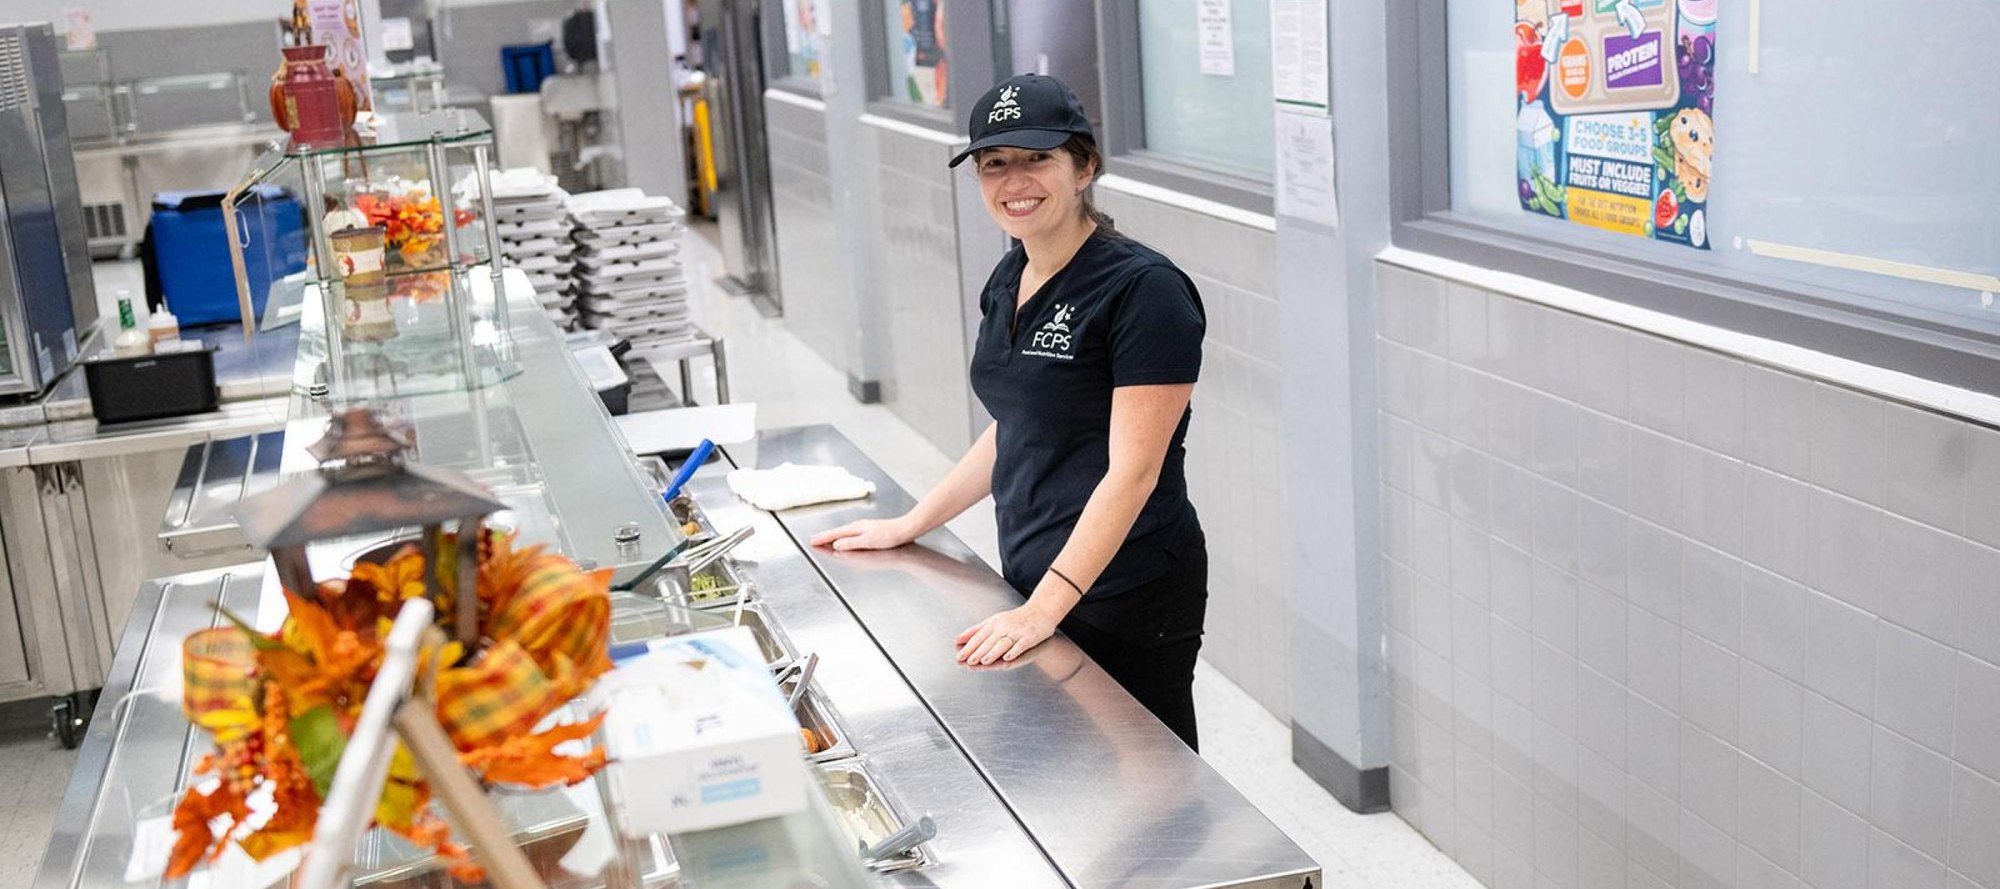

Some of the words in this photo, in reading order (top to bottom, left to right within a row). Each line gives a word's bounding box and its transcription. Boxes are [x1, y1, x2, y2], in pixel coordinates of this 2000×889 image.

[1607, 40, 1659, 74] PROTEIN
[988, 107, 1021, 124] FCPS
[1576, 120, 1624, 139] CHOOSE
[1628, 127, 1647, 142] 3-5
[1574, 136, 1603, 150] FOOD
[1606, 140, 1648, 157] GROUPS
[1570, 156, 1601, 176] MUST
[1602, 161, 1652, 184] INCLUDE
[1569, 172, 1597, 188] FRUITS
[1598, 176, 1611, 190] OR
[1032, 331, 1072, 351] FCPS
